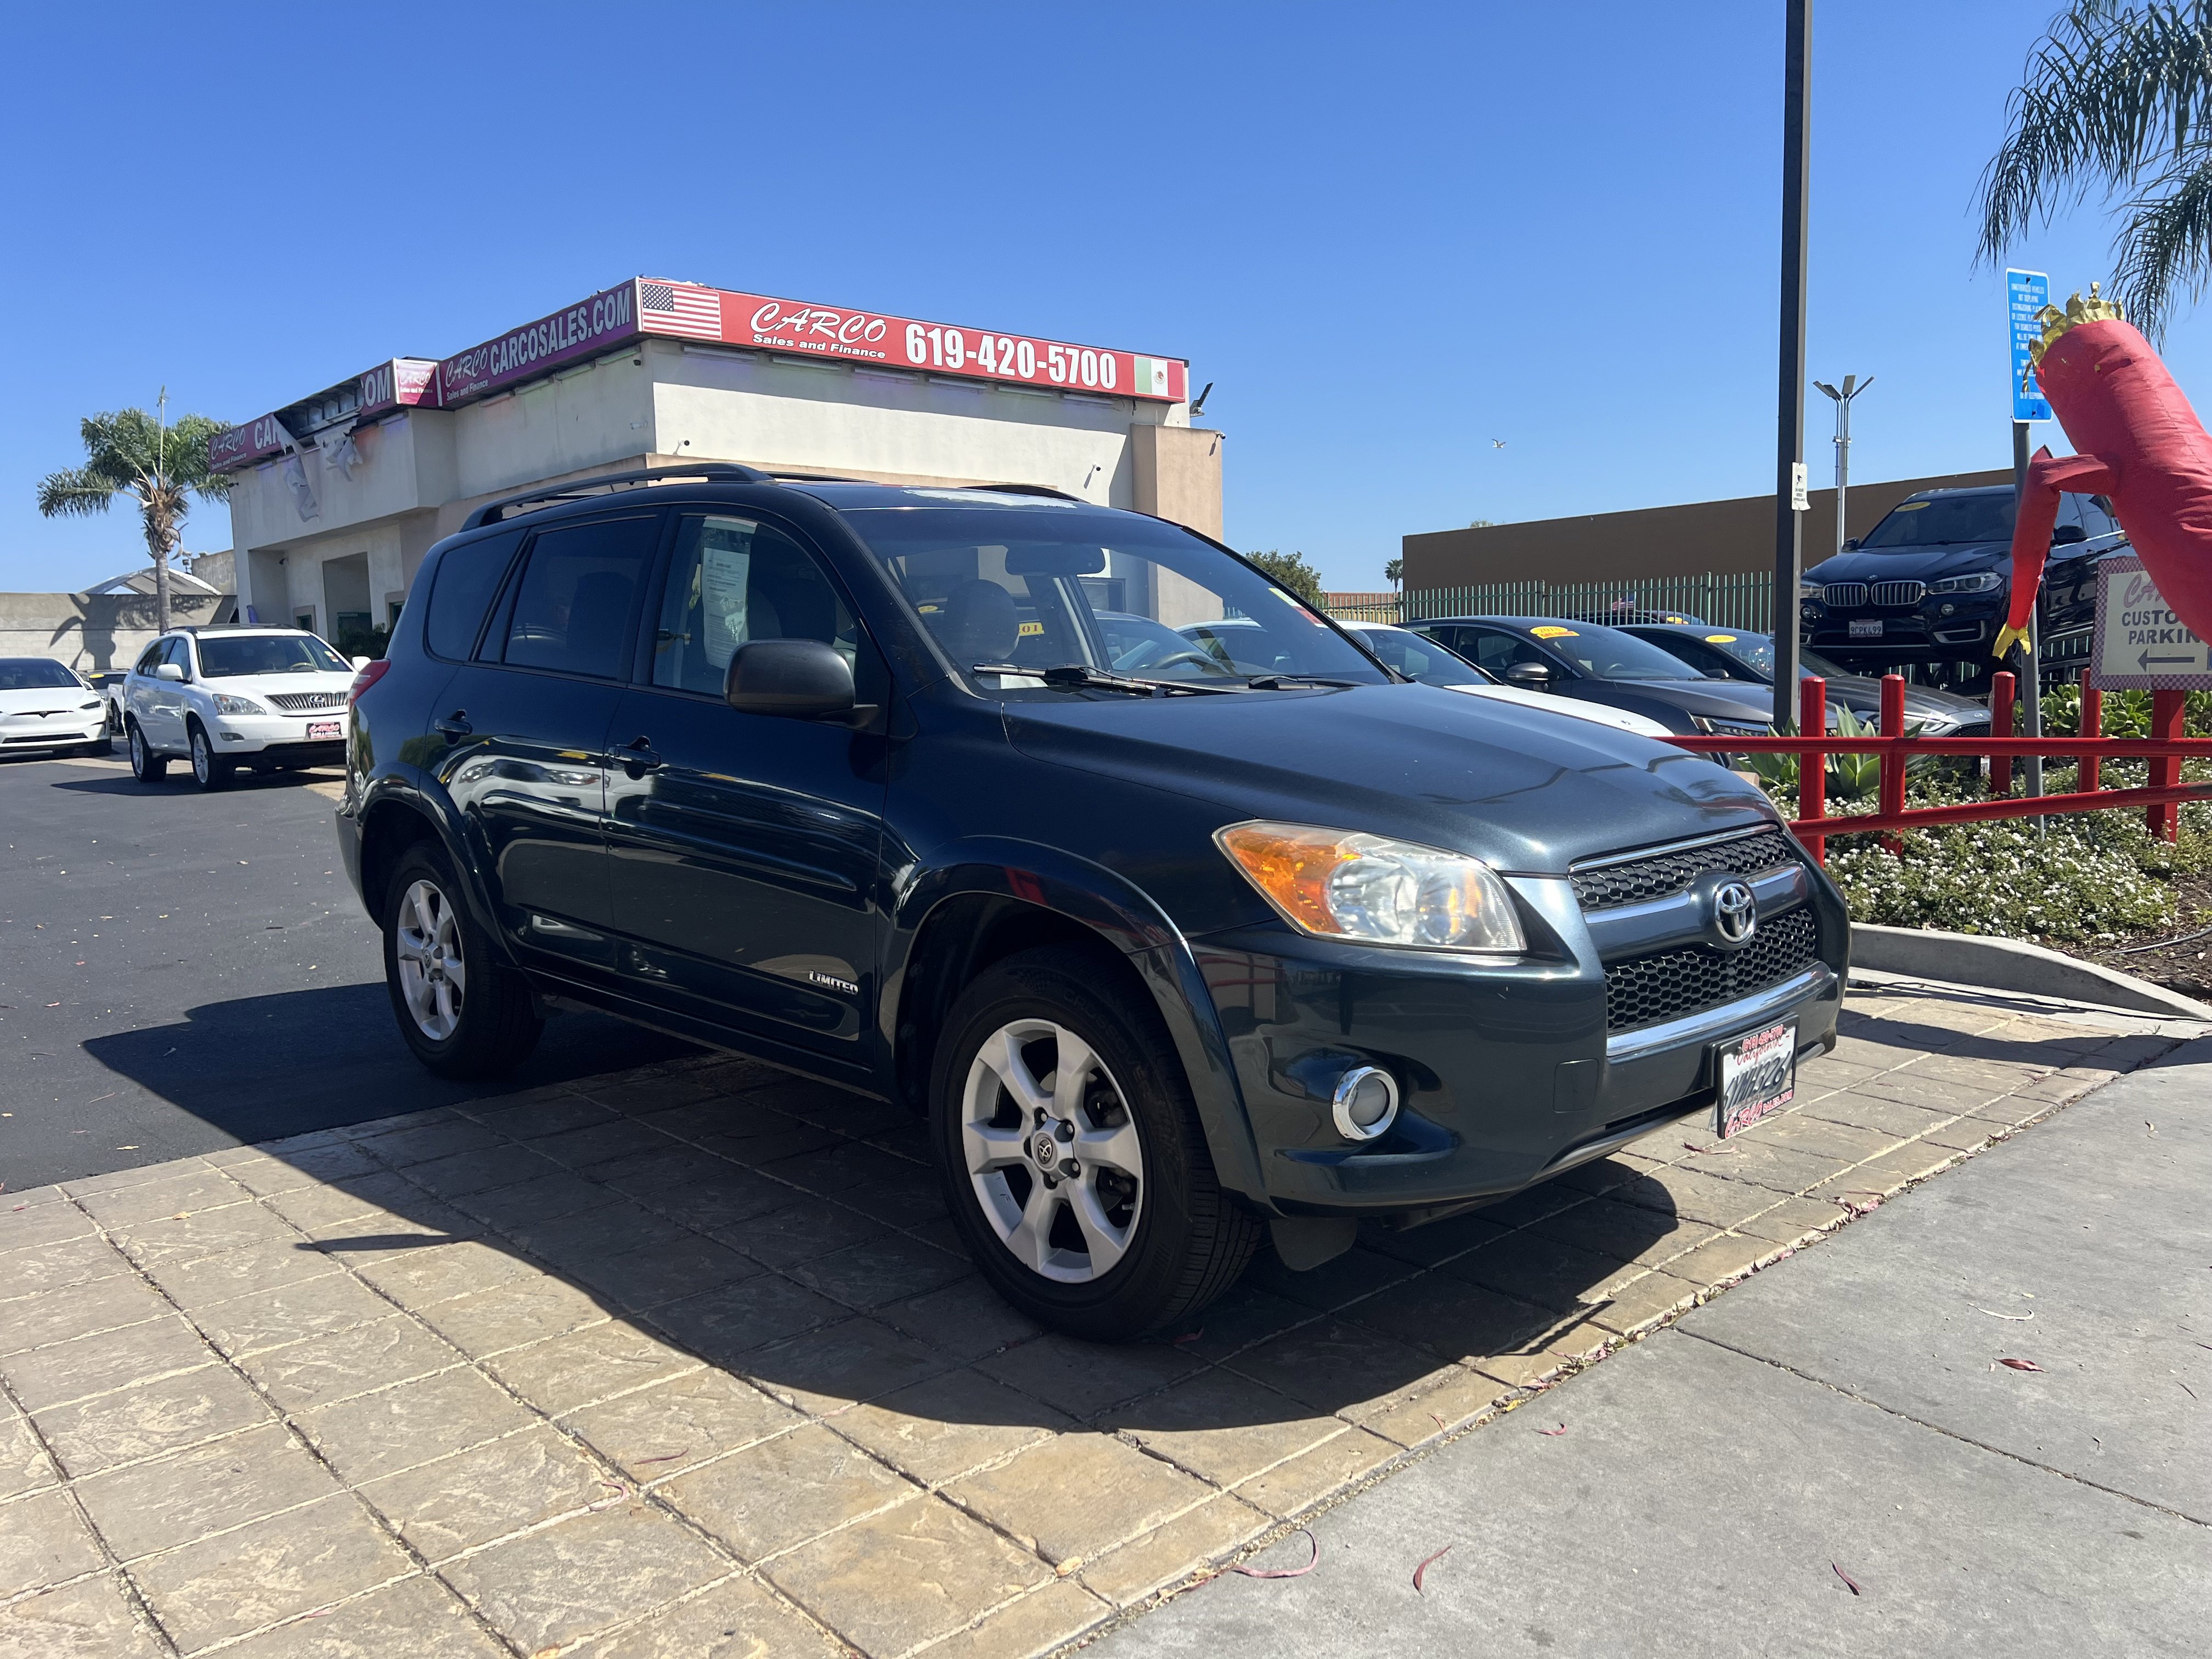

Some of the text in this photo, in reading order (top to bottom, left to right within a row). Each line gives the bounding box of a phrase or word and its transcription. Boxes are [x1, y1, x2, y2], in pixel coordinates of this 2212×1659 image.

[490, 286, 630, 376] CARCOSALES.COM
[750, 302, 887, 343] CARCO
[753, 334, 886, 359] Sales and Finance
[905, 323, 1116, 389] 619-420-5700
[445, 347, 488, 388] CARCO
[360, 365, 390, 407] OM
[447, 379, 488, 401] Sales and Finance
[211, 427, 246, 460] CARCO
[1850, 626, 1881, 635] 9CPK499
[2121, 610, 2180, 627] CUSTO
[2128, 629, 2200, 645] PARKIN
[809, 970, 859, 996] LIMITED
